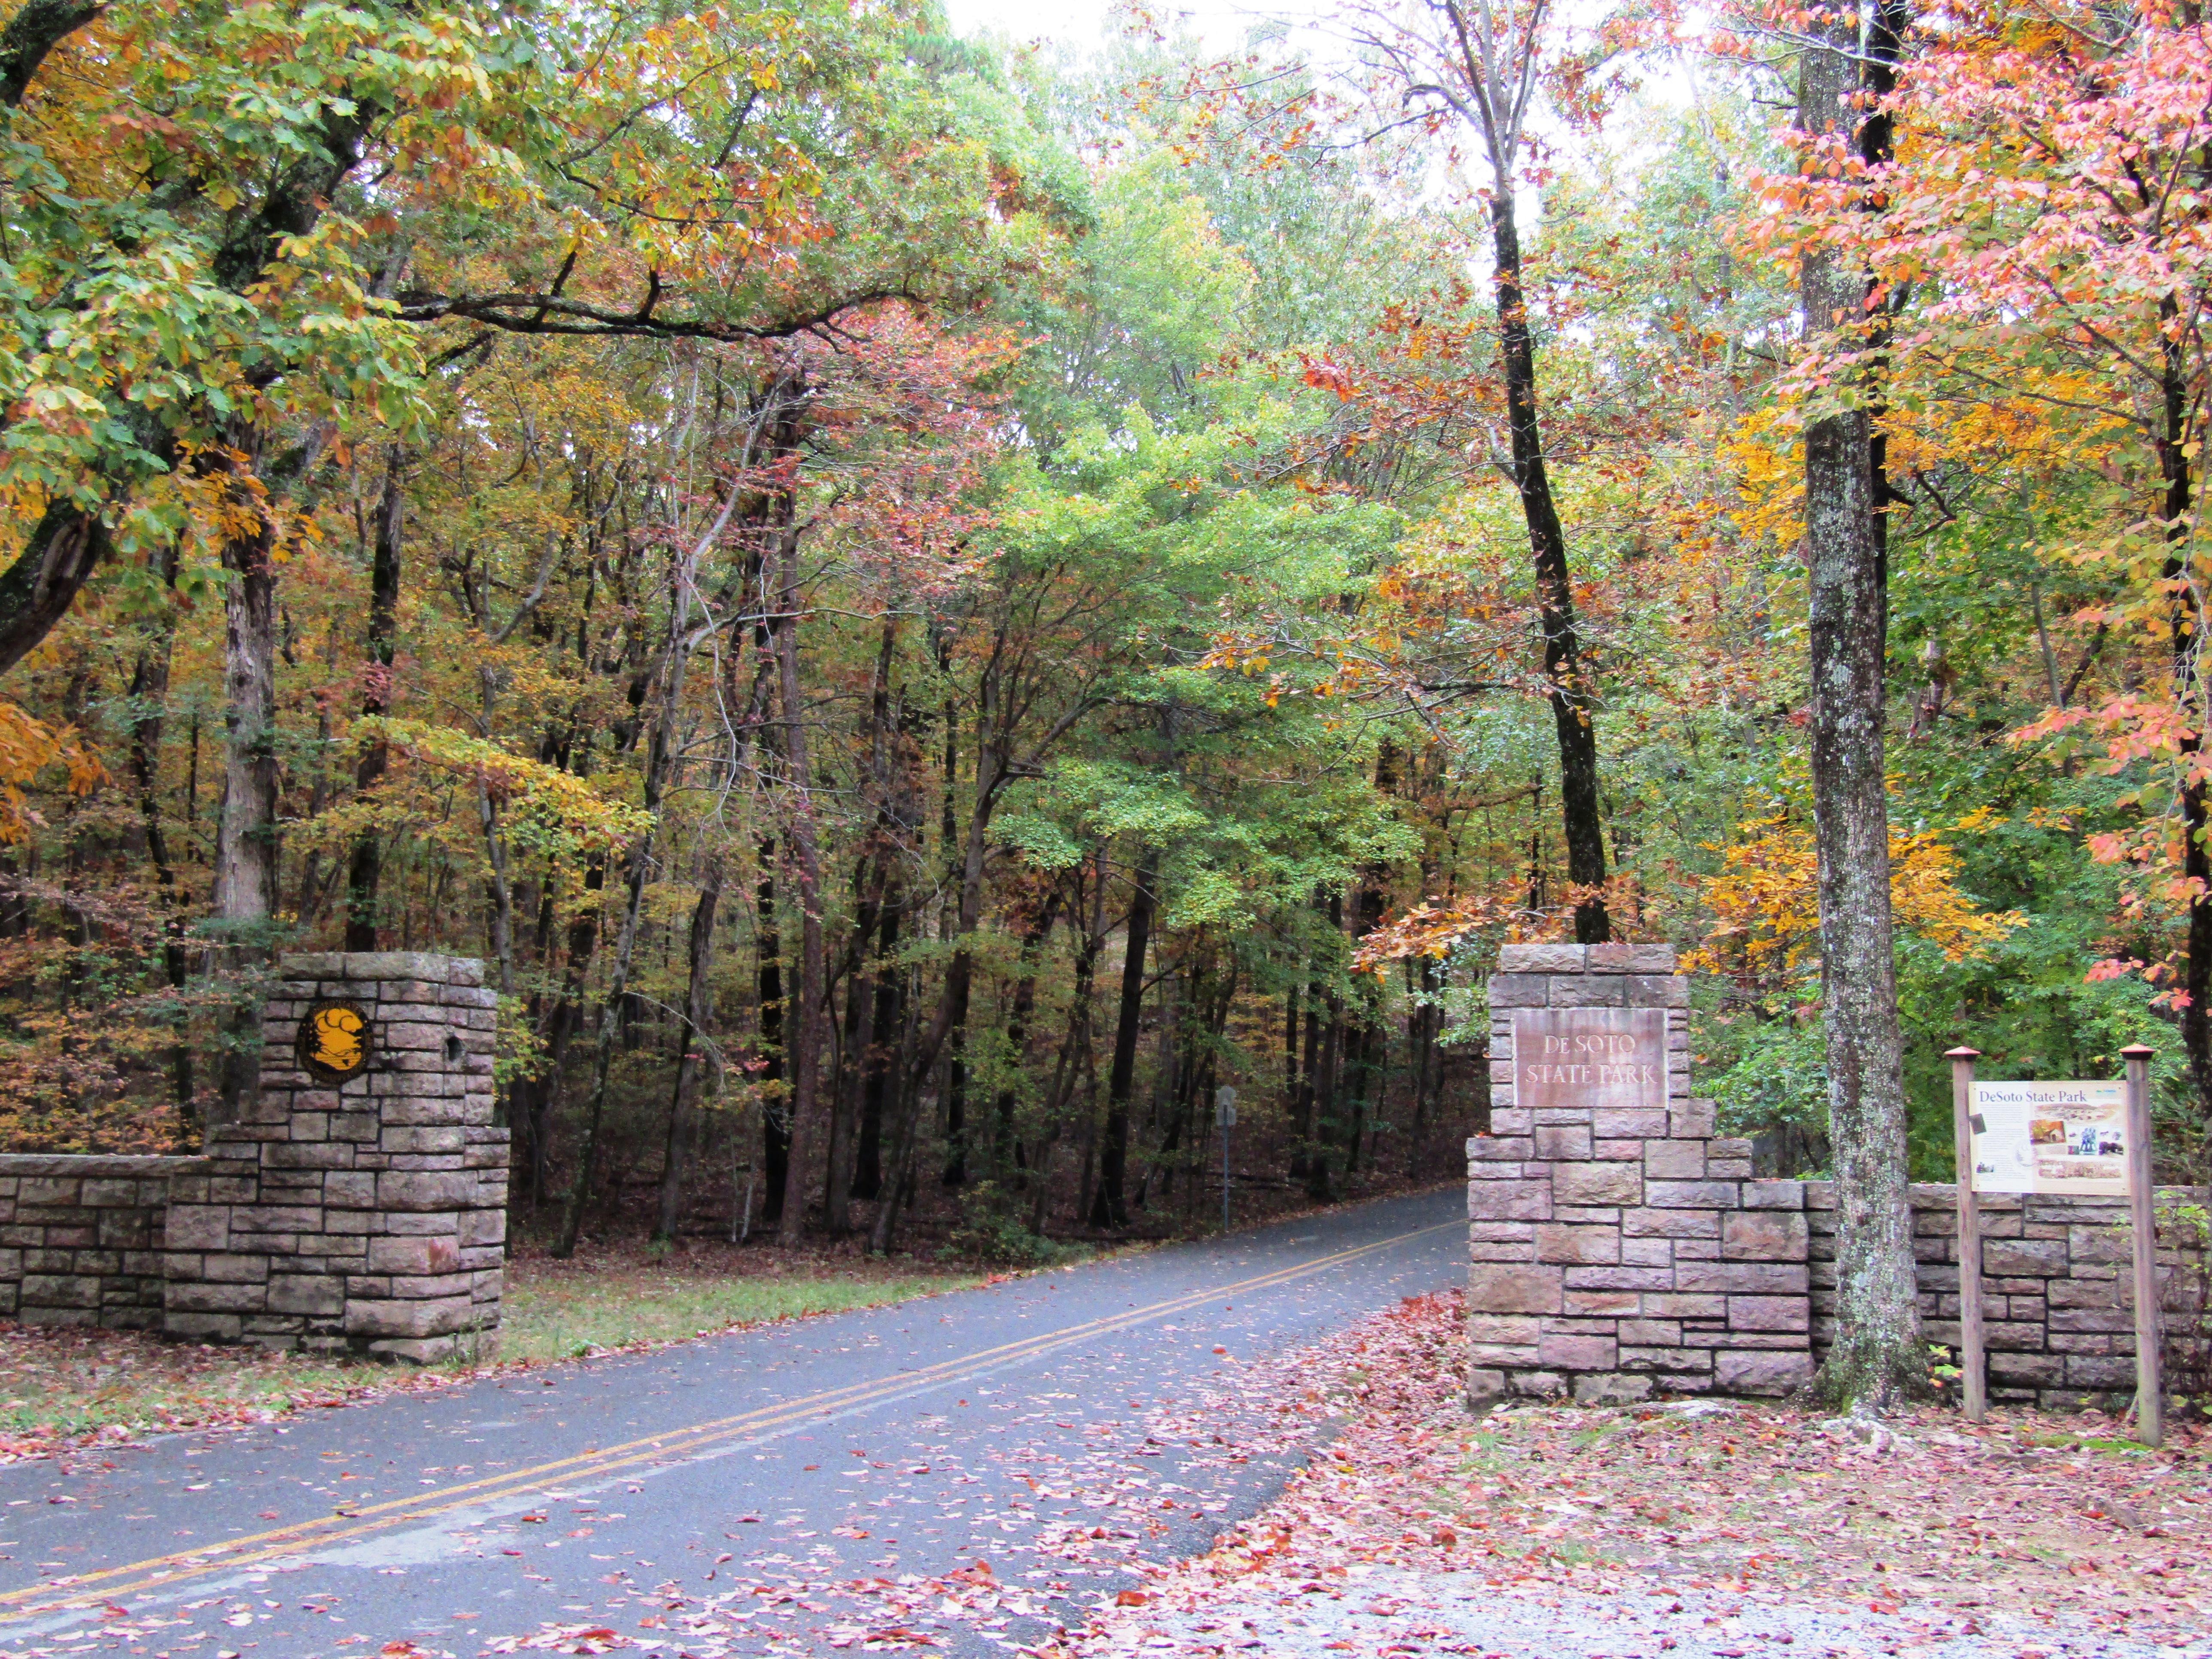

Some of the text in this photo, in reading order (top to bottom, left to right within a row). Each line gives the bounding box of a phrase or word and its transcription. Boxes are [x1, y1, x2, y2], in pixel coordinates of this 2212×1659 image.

[1525, 1064, 1658, 1084] STATE PARK
[1980, 1090, 2087, 1102] DeSoto State Park
